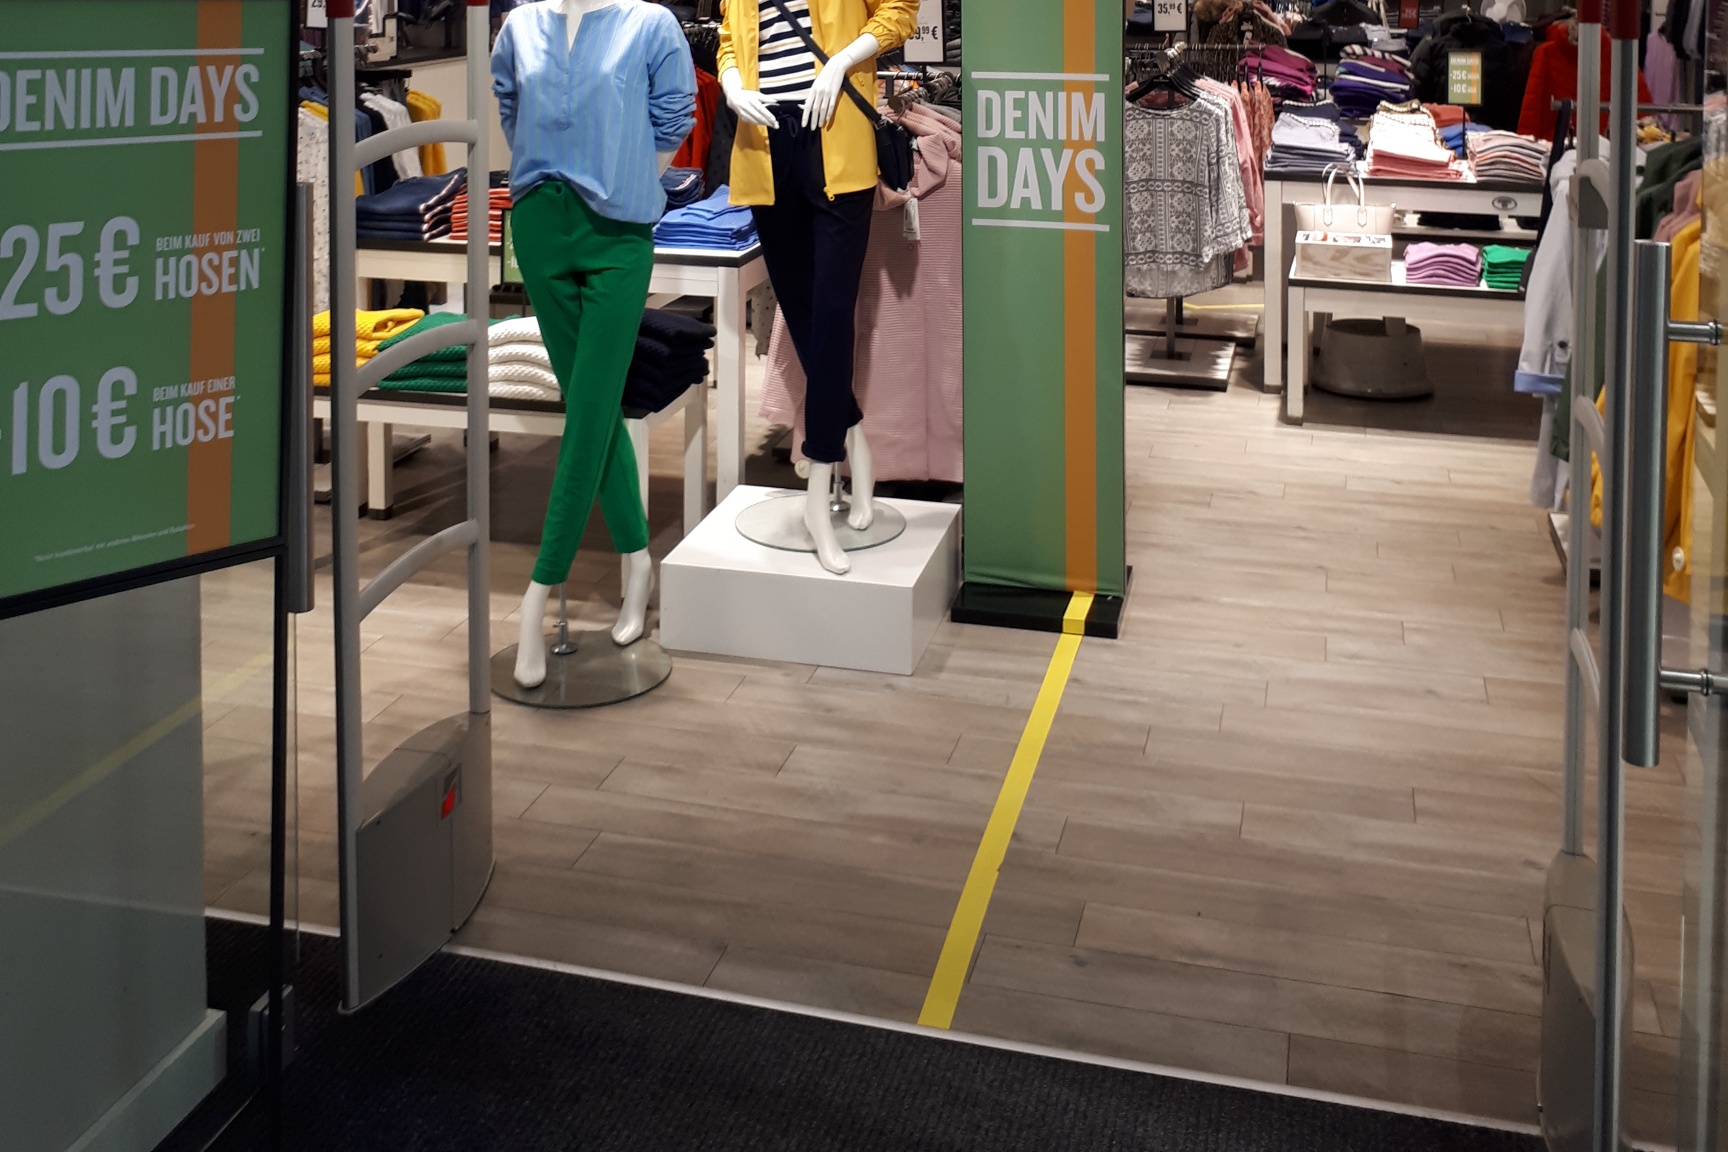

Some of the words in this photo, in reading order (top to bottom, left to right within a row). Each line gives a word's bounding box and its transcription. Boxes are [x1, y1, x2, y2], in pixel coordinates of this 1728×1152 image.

[909, 26, 930, 41] 9,99
[150, 63, 260, 126] DAYS
[977, 90, 1106, 142] DENIM
[977, 146, 1106, 214] DAYS
[156, 236, 182, 251] BEIM
[184, 233, 211, 250] KAUF
[213, 231, 234, 247] VON
[236, 228, 260, 244] ZWEI
[153, 385, 179, 402] BEIM
[180, 381, 206, 398] KAUF
[207, 376, 236, 393] EINER
